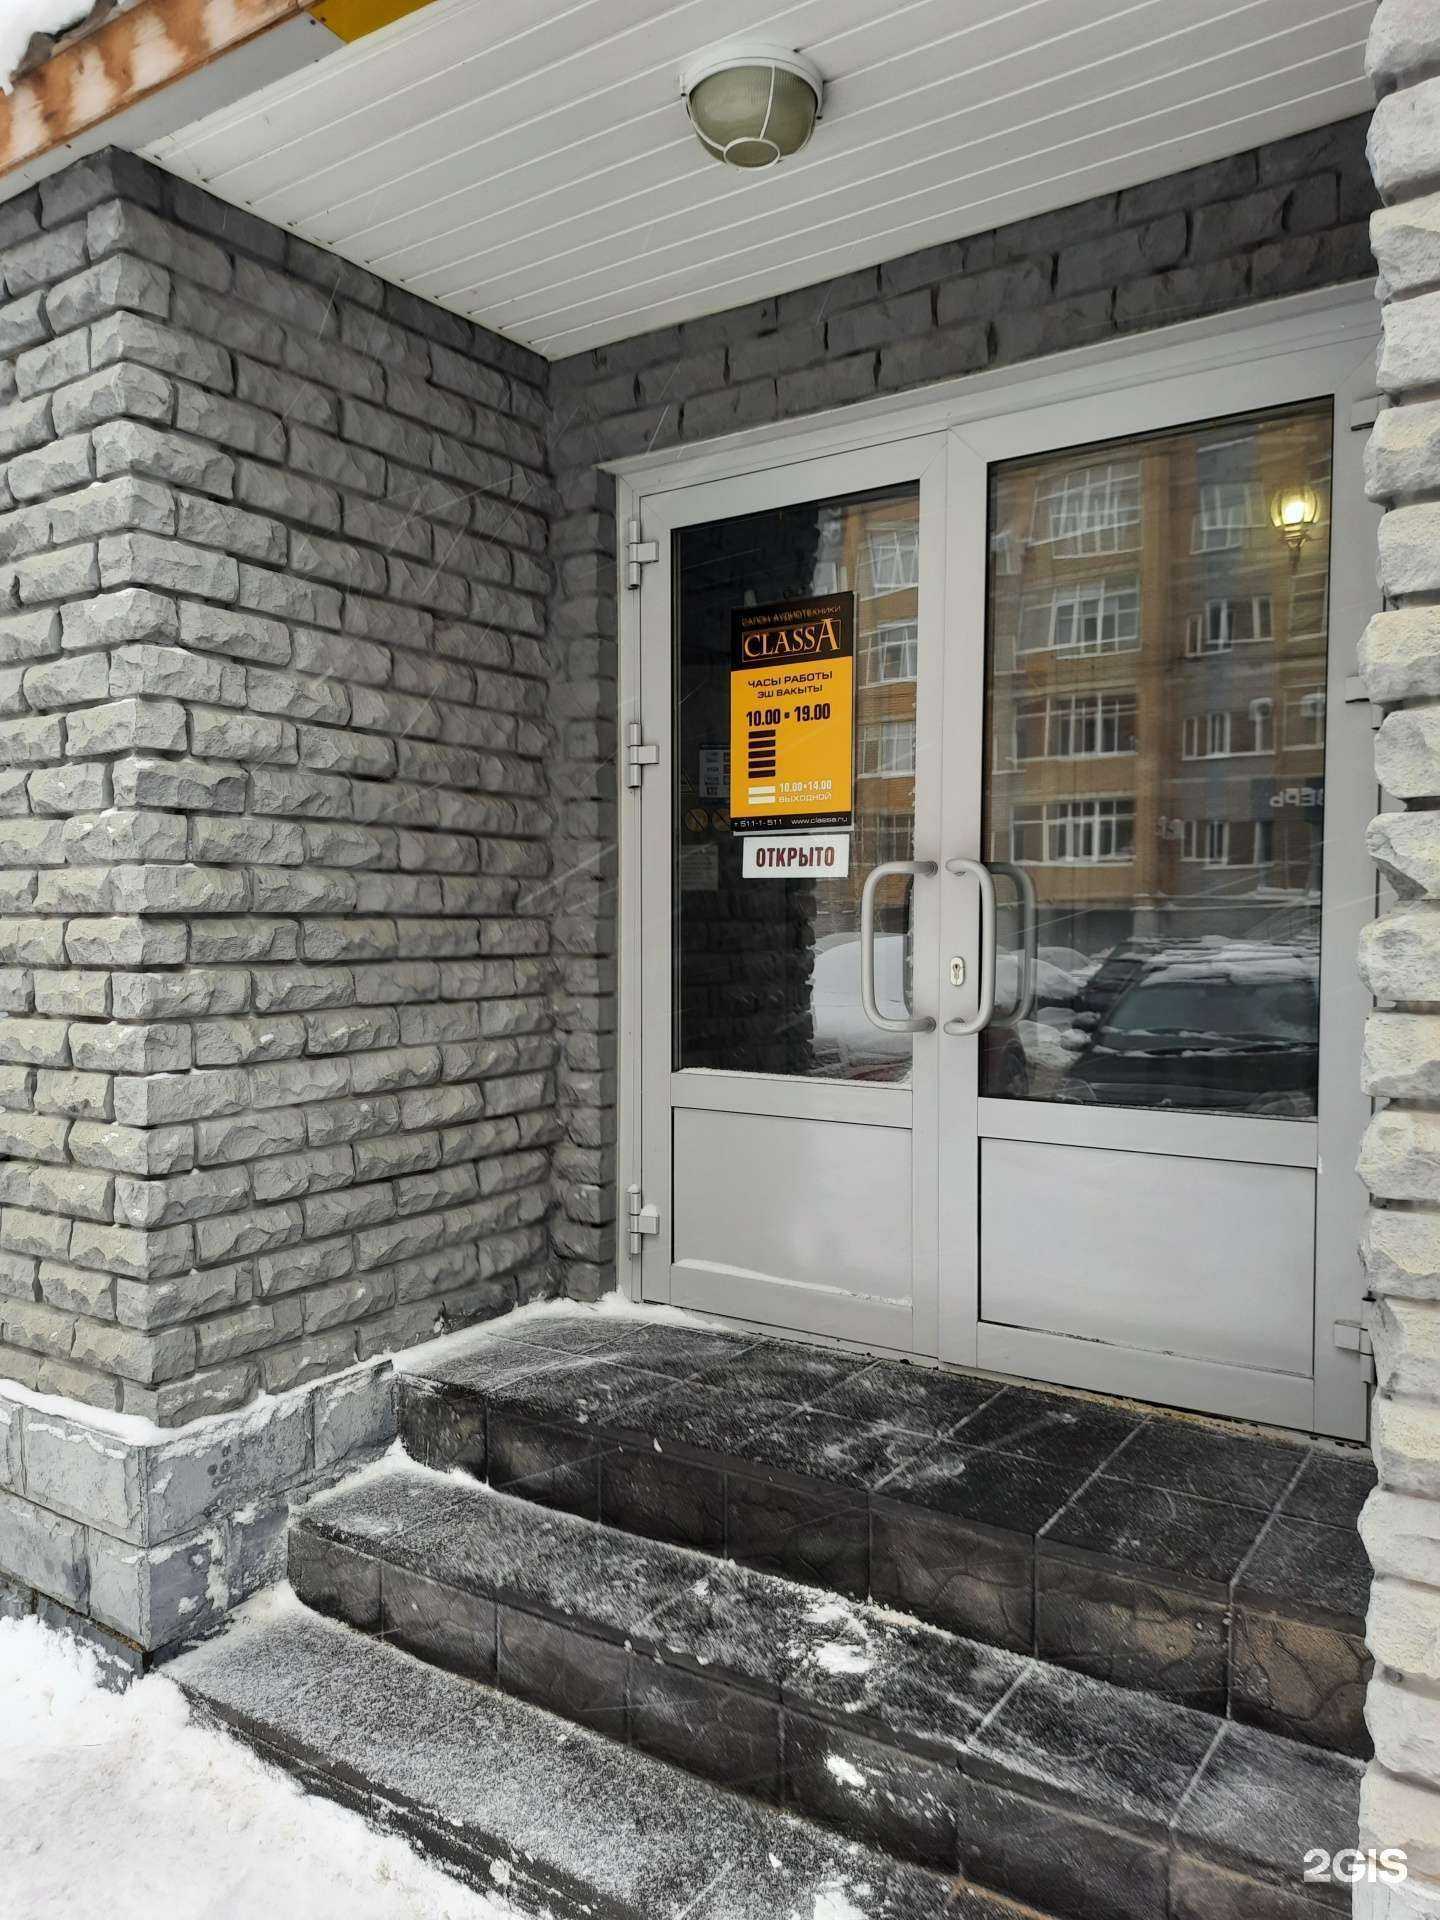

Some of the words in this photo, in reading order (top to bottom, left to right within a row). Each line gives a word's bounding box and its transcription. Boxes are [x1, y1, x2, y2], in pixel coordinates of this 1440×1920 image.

[744, 618, 841, 658] CLASSA
[748, 678, 781, 688] ЧАСЫ
[784, 670, 833, 685] РАБОТЫ
[757, 690, 774, 699] ЭШ
[776, 684, 823, 697] ВАКЫТЫ
[746, 708, 781, 727] 10.00
[794, 702, 831, 722] 19.00
[778, 791, 832, 804] ВЫХОДНОЙ
[791, 816, 848, 825] www.classa.ru
[755, 846, 835, 868] ОТКРЫТО
